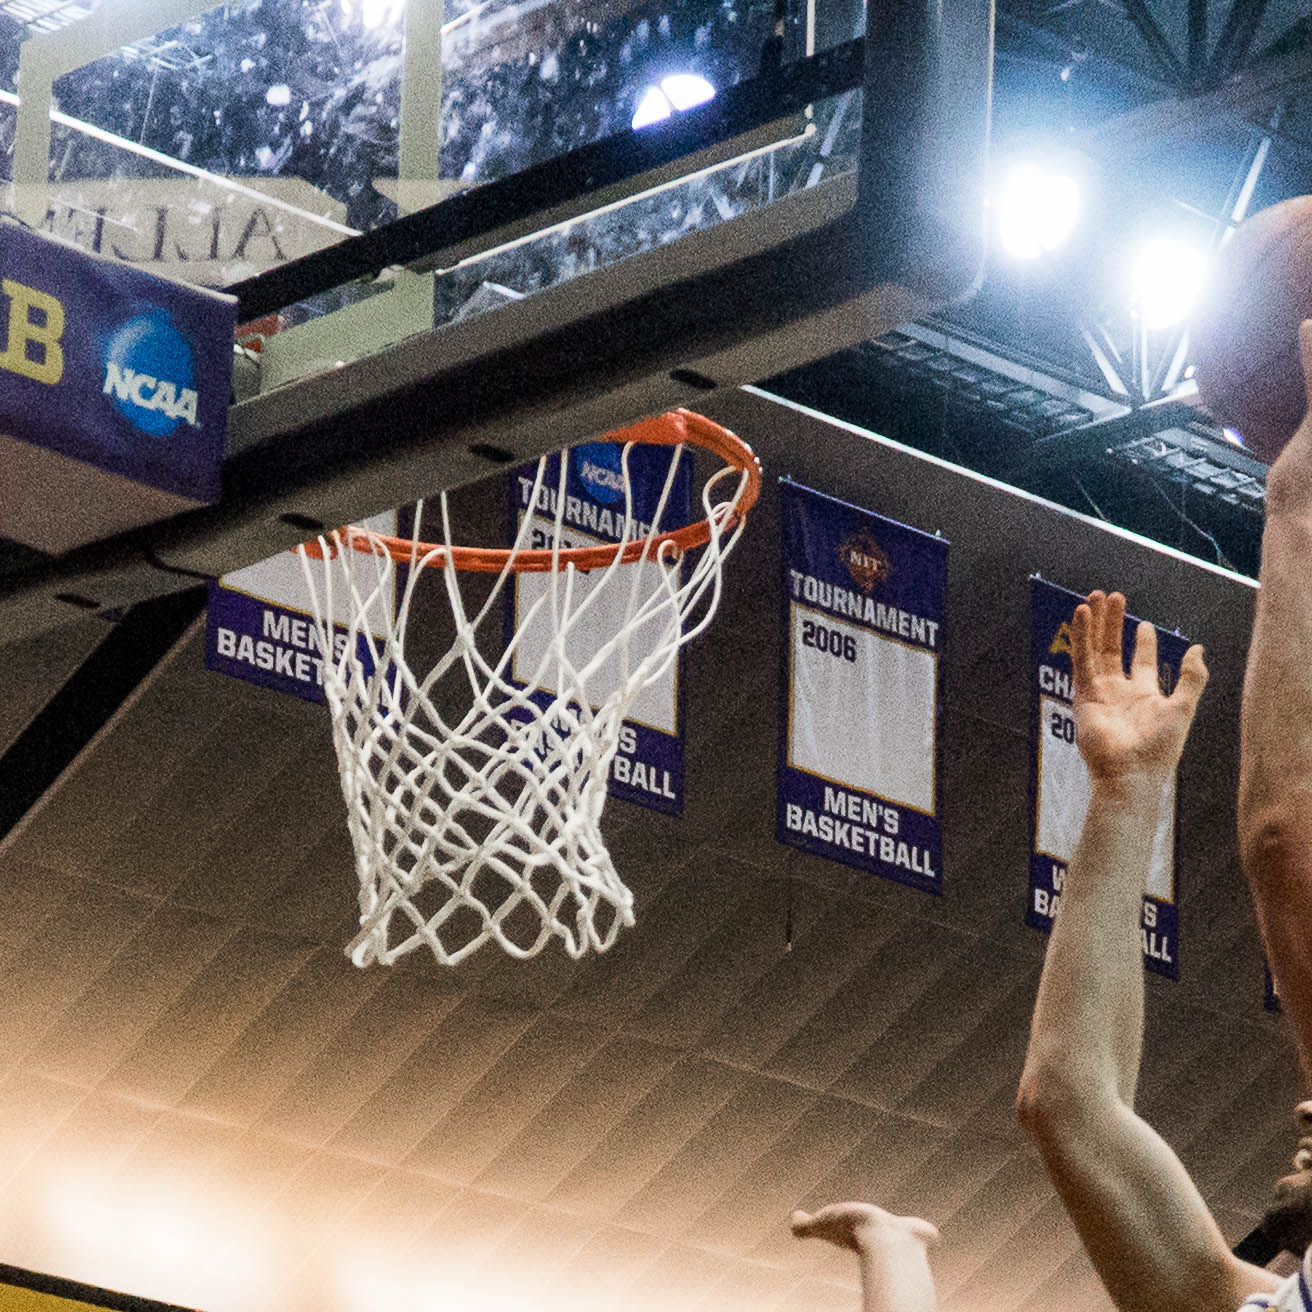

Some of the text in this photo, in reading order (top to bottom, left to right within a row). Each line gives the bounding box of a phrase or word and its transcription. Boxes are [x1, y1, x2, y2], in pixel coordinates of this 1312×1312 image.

[102, 361, 199, 425] NCAA
[263, 610, 351, 662] MENS
[790, 570, 938, 647] TOURNAMENT
[802, 620, 857, 663] 2006
[824, 786, 899, 835] MEN'S
[787, 803, 935, 878] BASKETBALL
